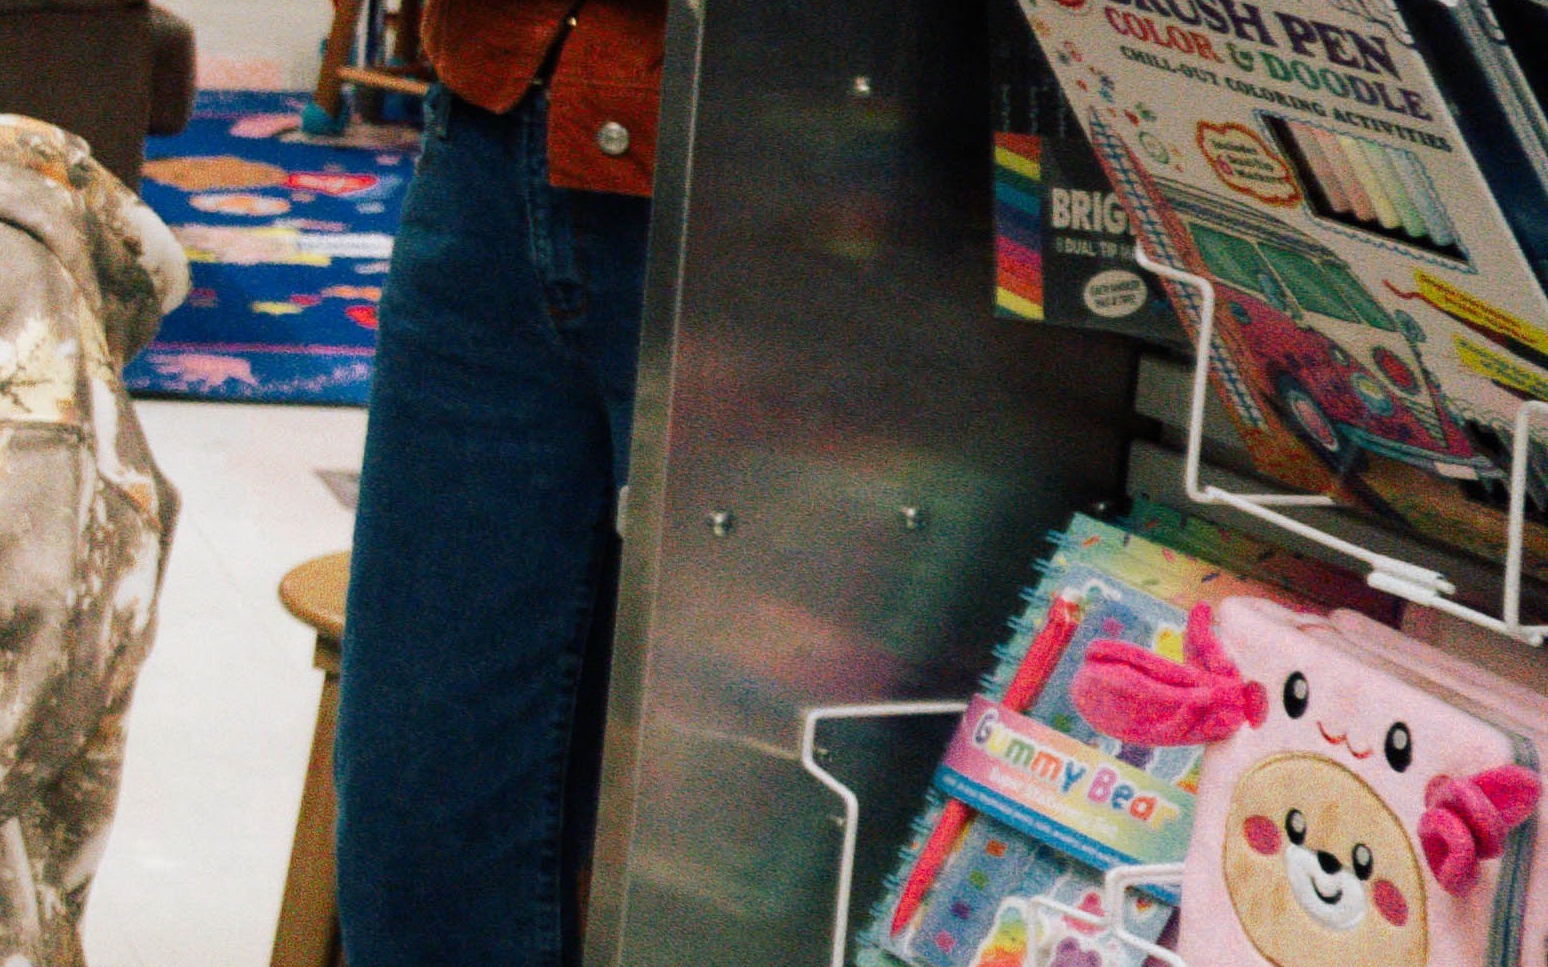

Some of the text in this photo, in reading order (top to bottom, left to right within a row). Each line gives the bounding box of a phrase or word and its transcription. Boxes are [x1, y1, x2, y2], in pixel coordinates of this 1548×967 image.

[1105, 6, 1225, 65] COLOR
[1258, 50, 1434, 122] DOODLE
[1274, 9, 1404, 83] PEN
[1330, 106, 1454, 154] ACTIVITIES
[1050, 187, 1129, 233] BRIG
[973, 708, 1087, 794] Gummy
[1086, 763, 1181, 830] Bear
